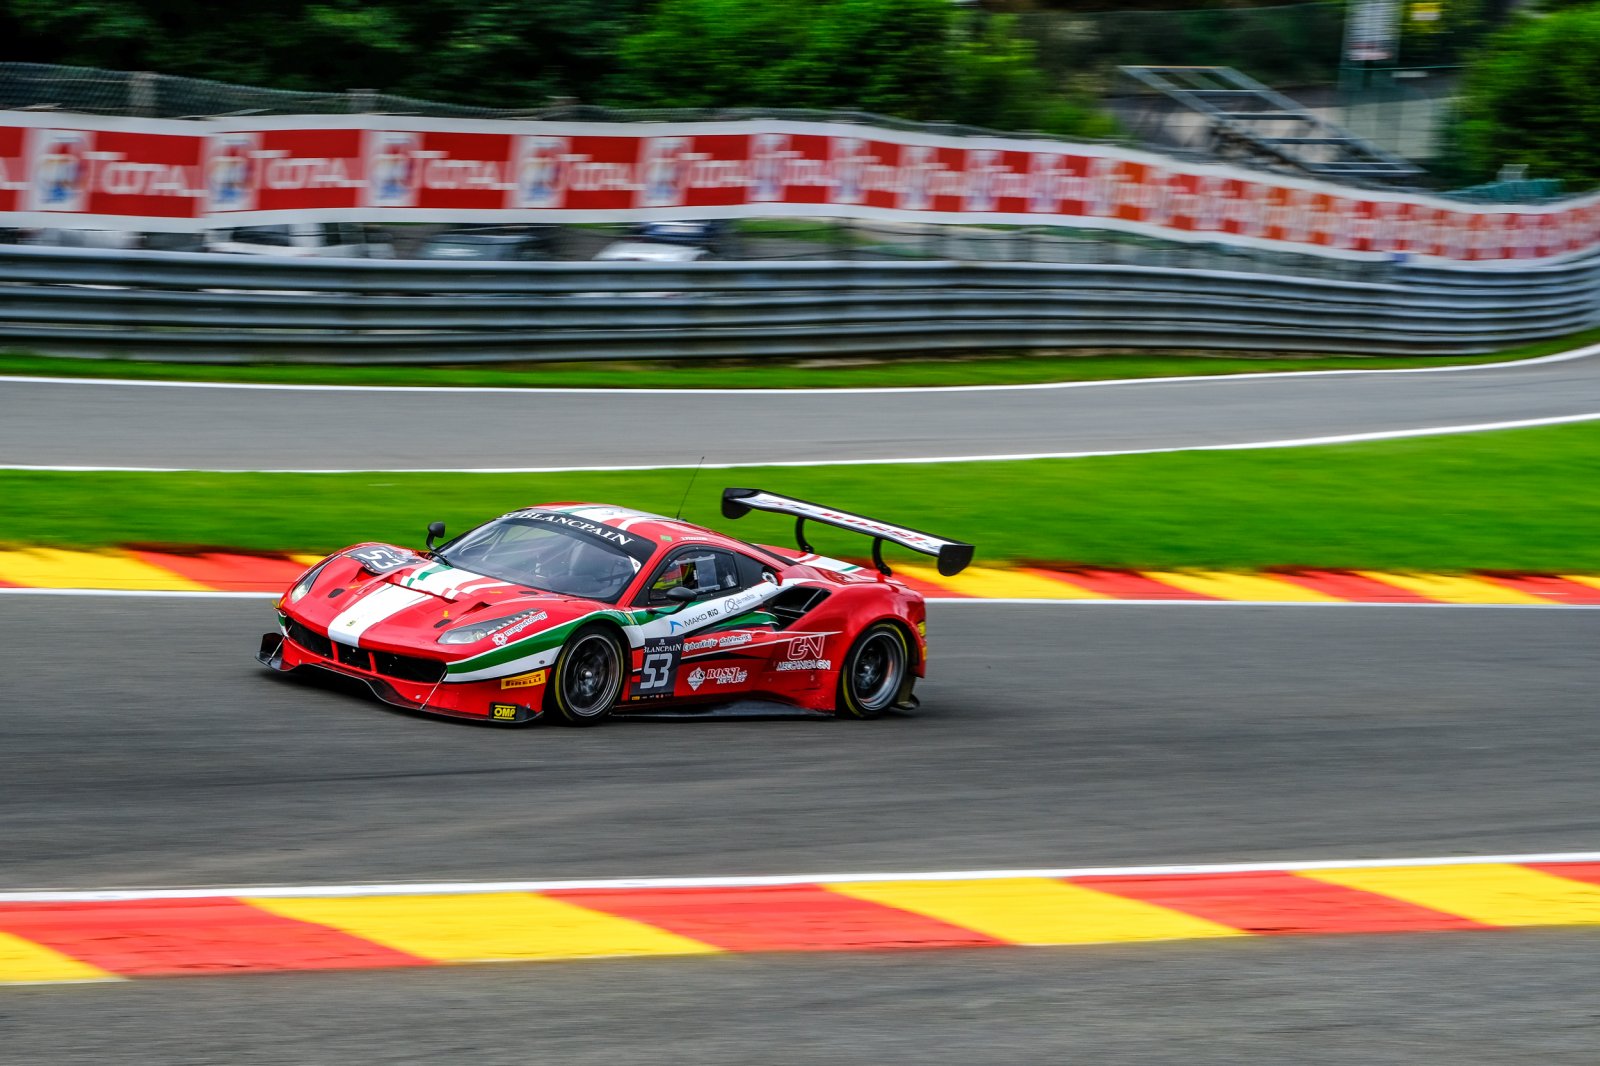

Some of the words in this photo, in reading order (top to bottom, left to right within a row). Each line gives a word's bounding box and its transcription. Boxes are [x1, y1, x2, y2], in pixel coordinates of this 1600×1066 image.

[80, 151, 209, 198] TOTAL
[248, 149, 368, 190] TOTAL
[407, 150, 521, 191] TOTAL
[556, 152, 648, 191] TOTAL
[517, 511, 634, 546] BLANCPAIN
[356, 549, 407, 570] 53
[504, 611, 548, 637] magnetology
[683, 612, 708, 628] MAKO
[643, 643, 682, 654] BLANCPAIN
[683, 638, 718, 652] CyberKnife
[786, 634, 826, 661] GN
[504, 673, 542, 687] PIRELLI
[639, 652, 673, 690] 53
[705, 666, 741, 684] ROSSI
[493, 707, 517, 718] OMP
